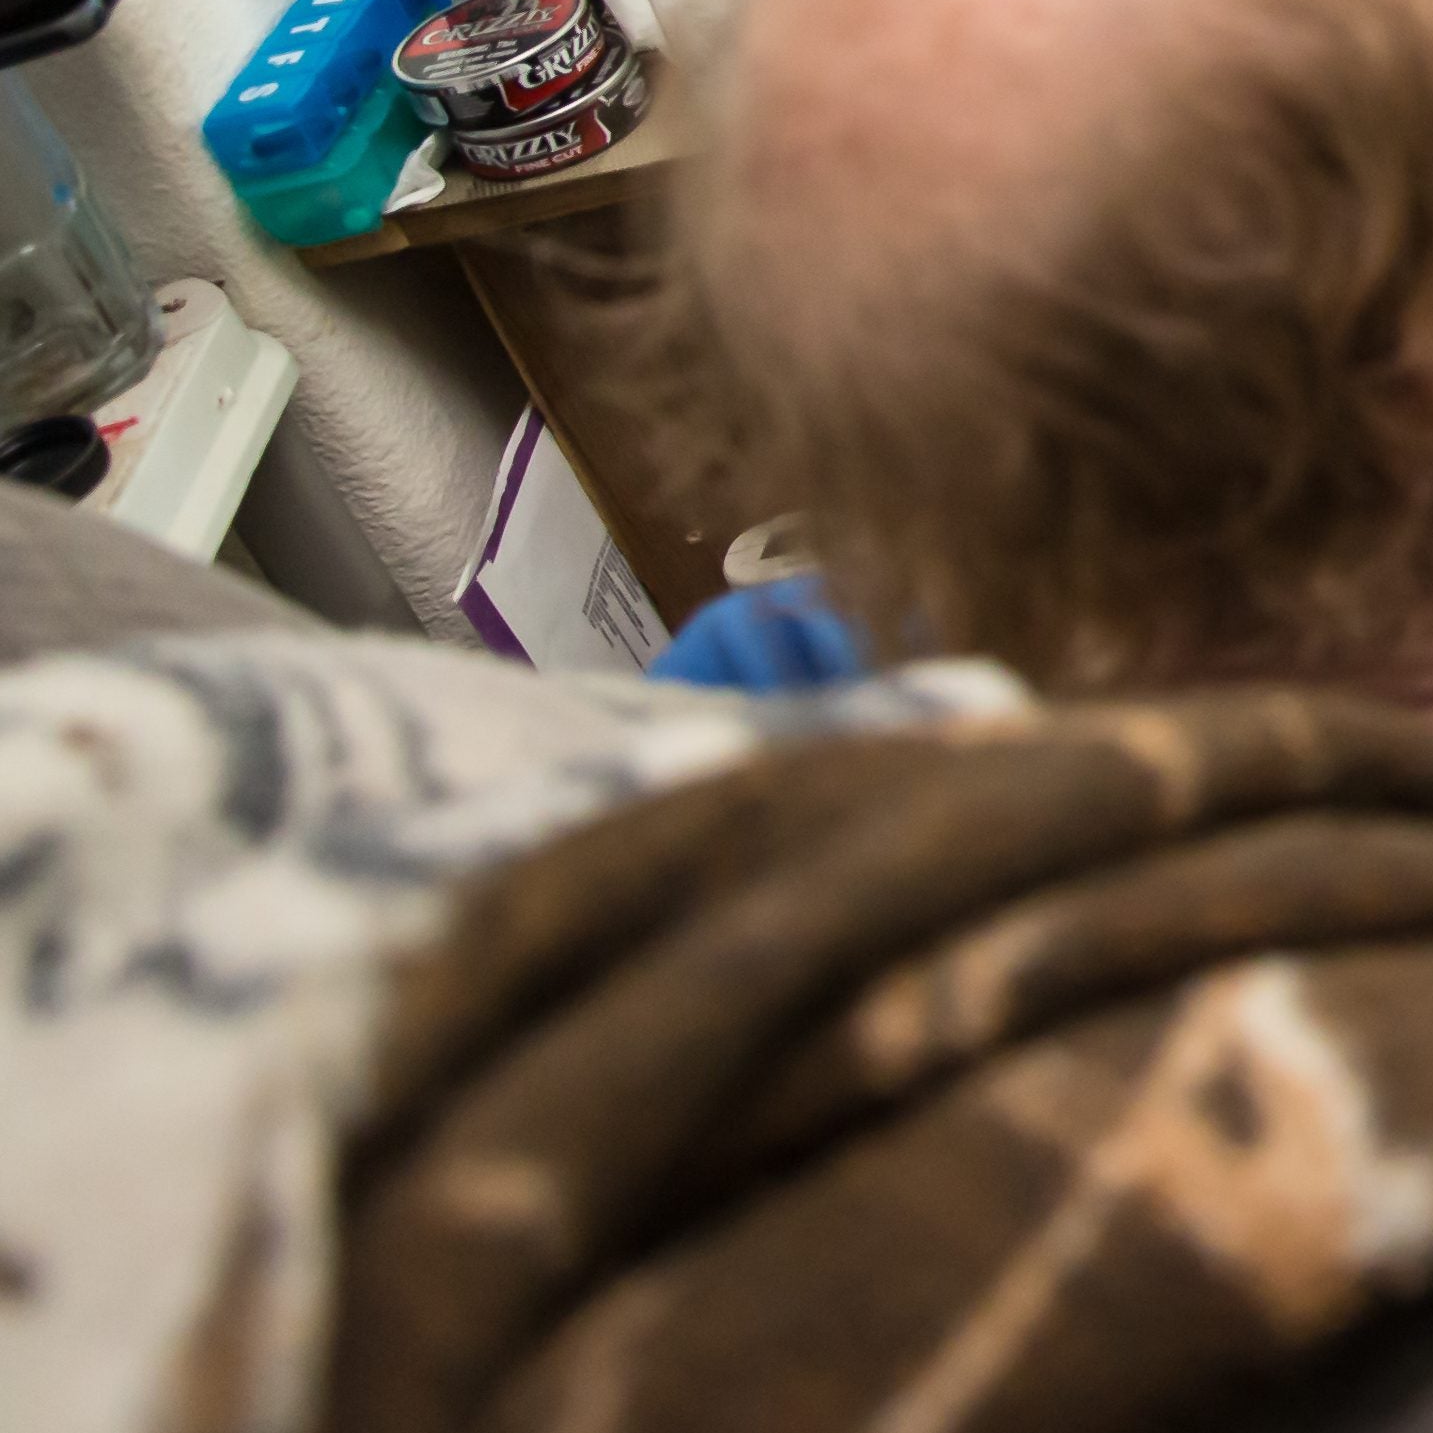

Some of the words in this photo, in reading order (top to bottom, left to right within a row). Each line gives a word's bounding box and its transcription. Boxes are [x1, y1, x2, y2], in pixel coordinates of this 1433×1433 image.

[290, 16, 330, 34] T
[421, 4, 562, 45] GRIZZLY
[267, 50, 305, 66] F
[238, 82, 279, 102] S
[462, 121, 582, 168] GRIZZLY
[515, 156, 551, 173] FINE
[552, 145, 583, 164] CUT
